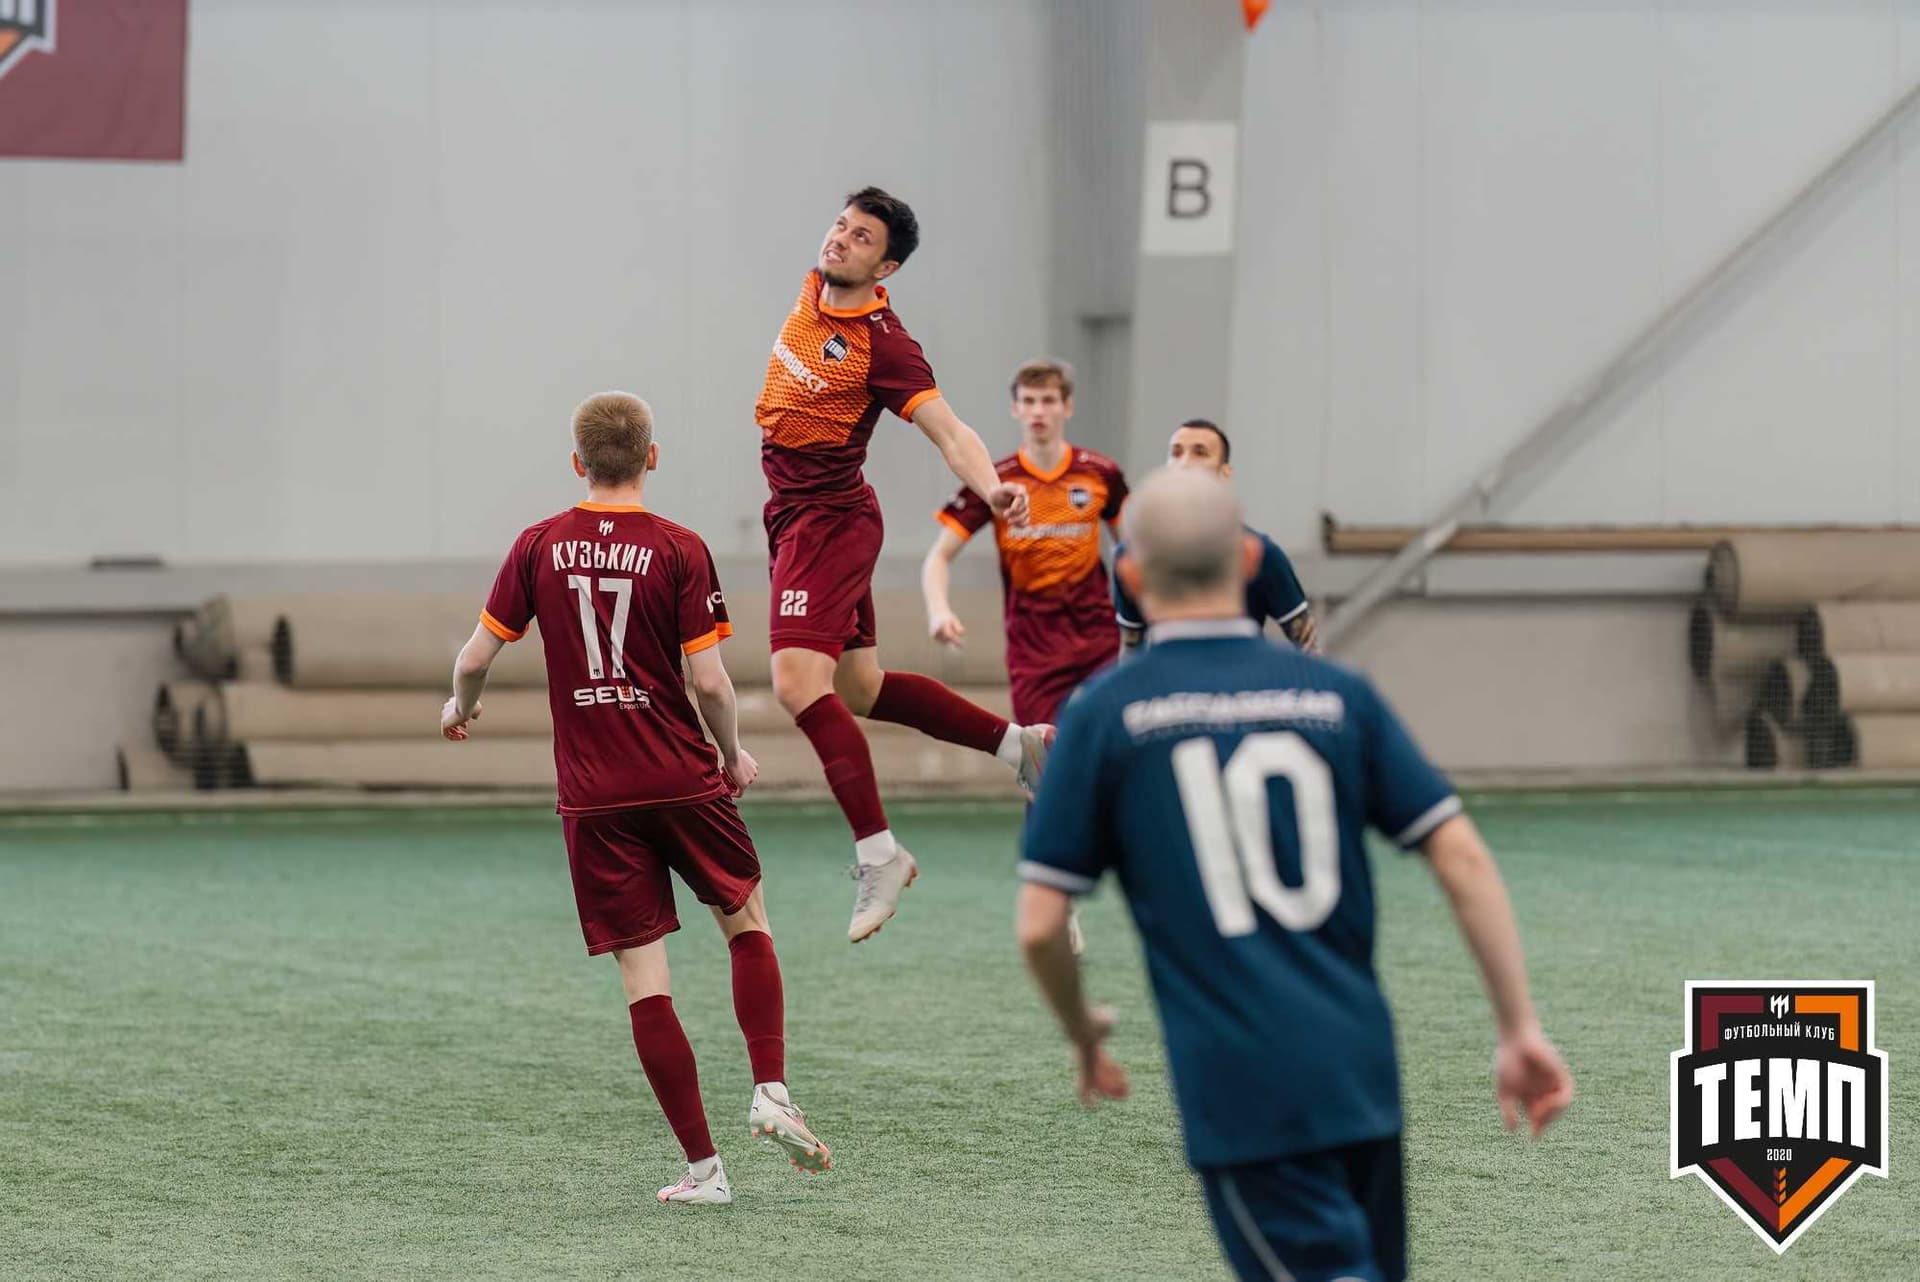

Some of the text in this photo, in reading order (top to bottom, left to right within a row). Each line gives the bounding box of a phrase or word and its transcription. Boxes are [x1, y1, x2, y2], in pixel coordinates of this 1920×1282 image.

[552, 540, 653, 576] КУЗЬКИН
[780, 589, 808, 616] 22
[567, 574, 633, 679] 17
[573, 685, 650, 707] SEUS
[1171, 730, 1342, 937] 10
